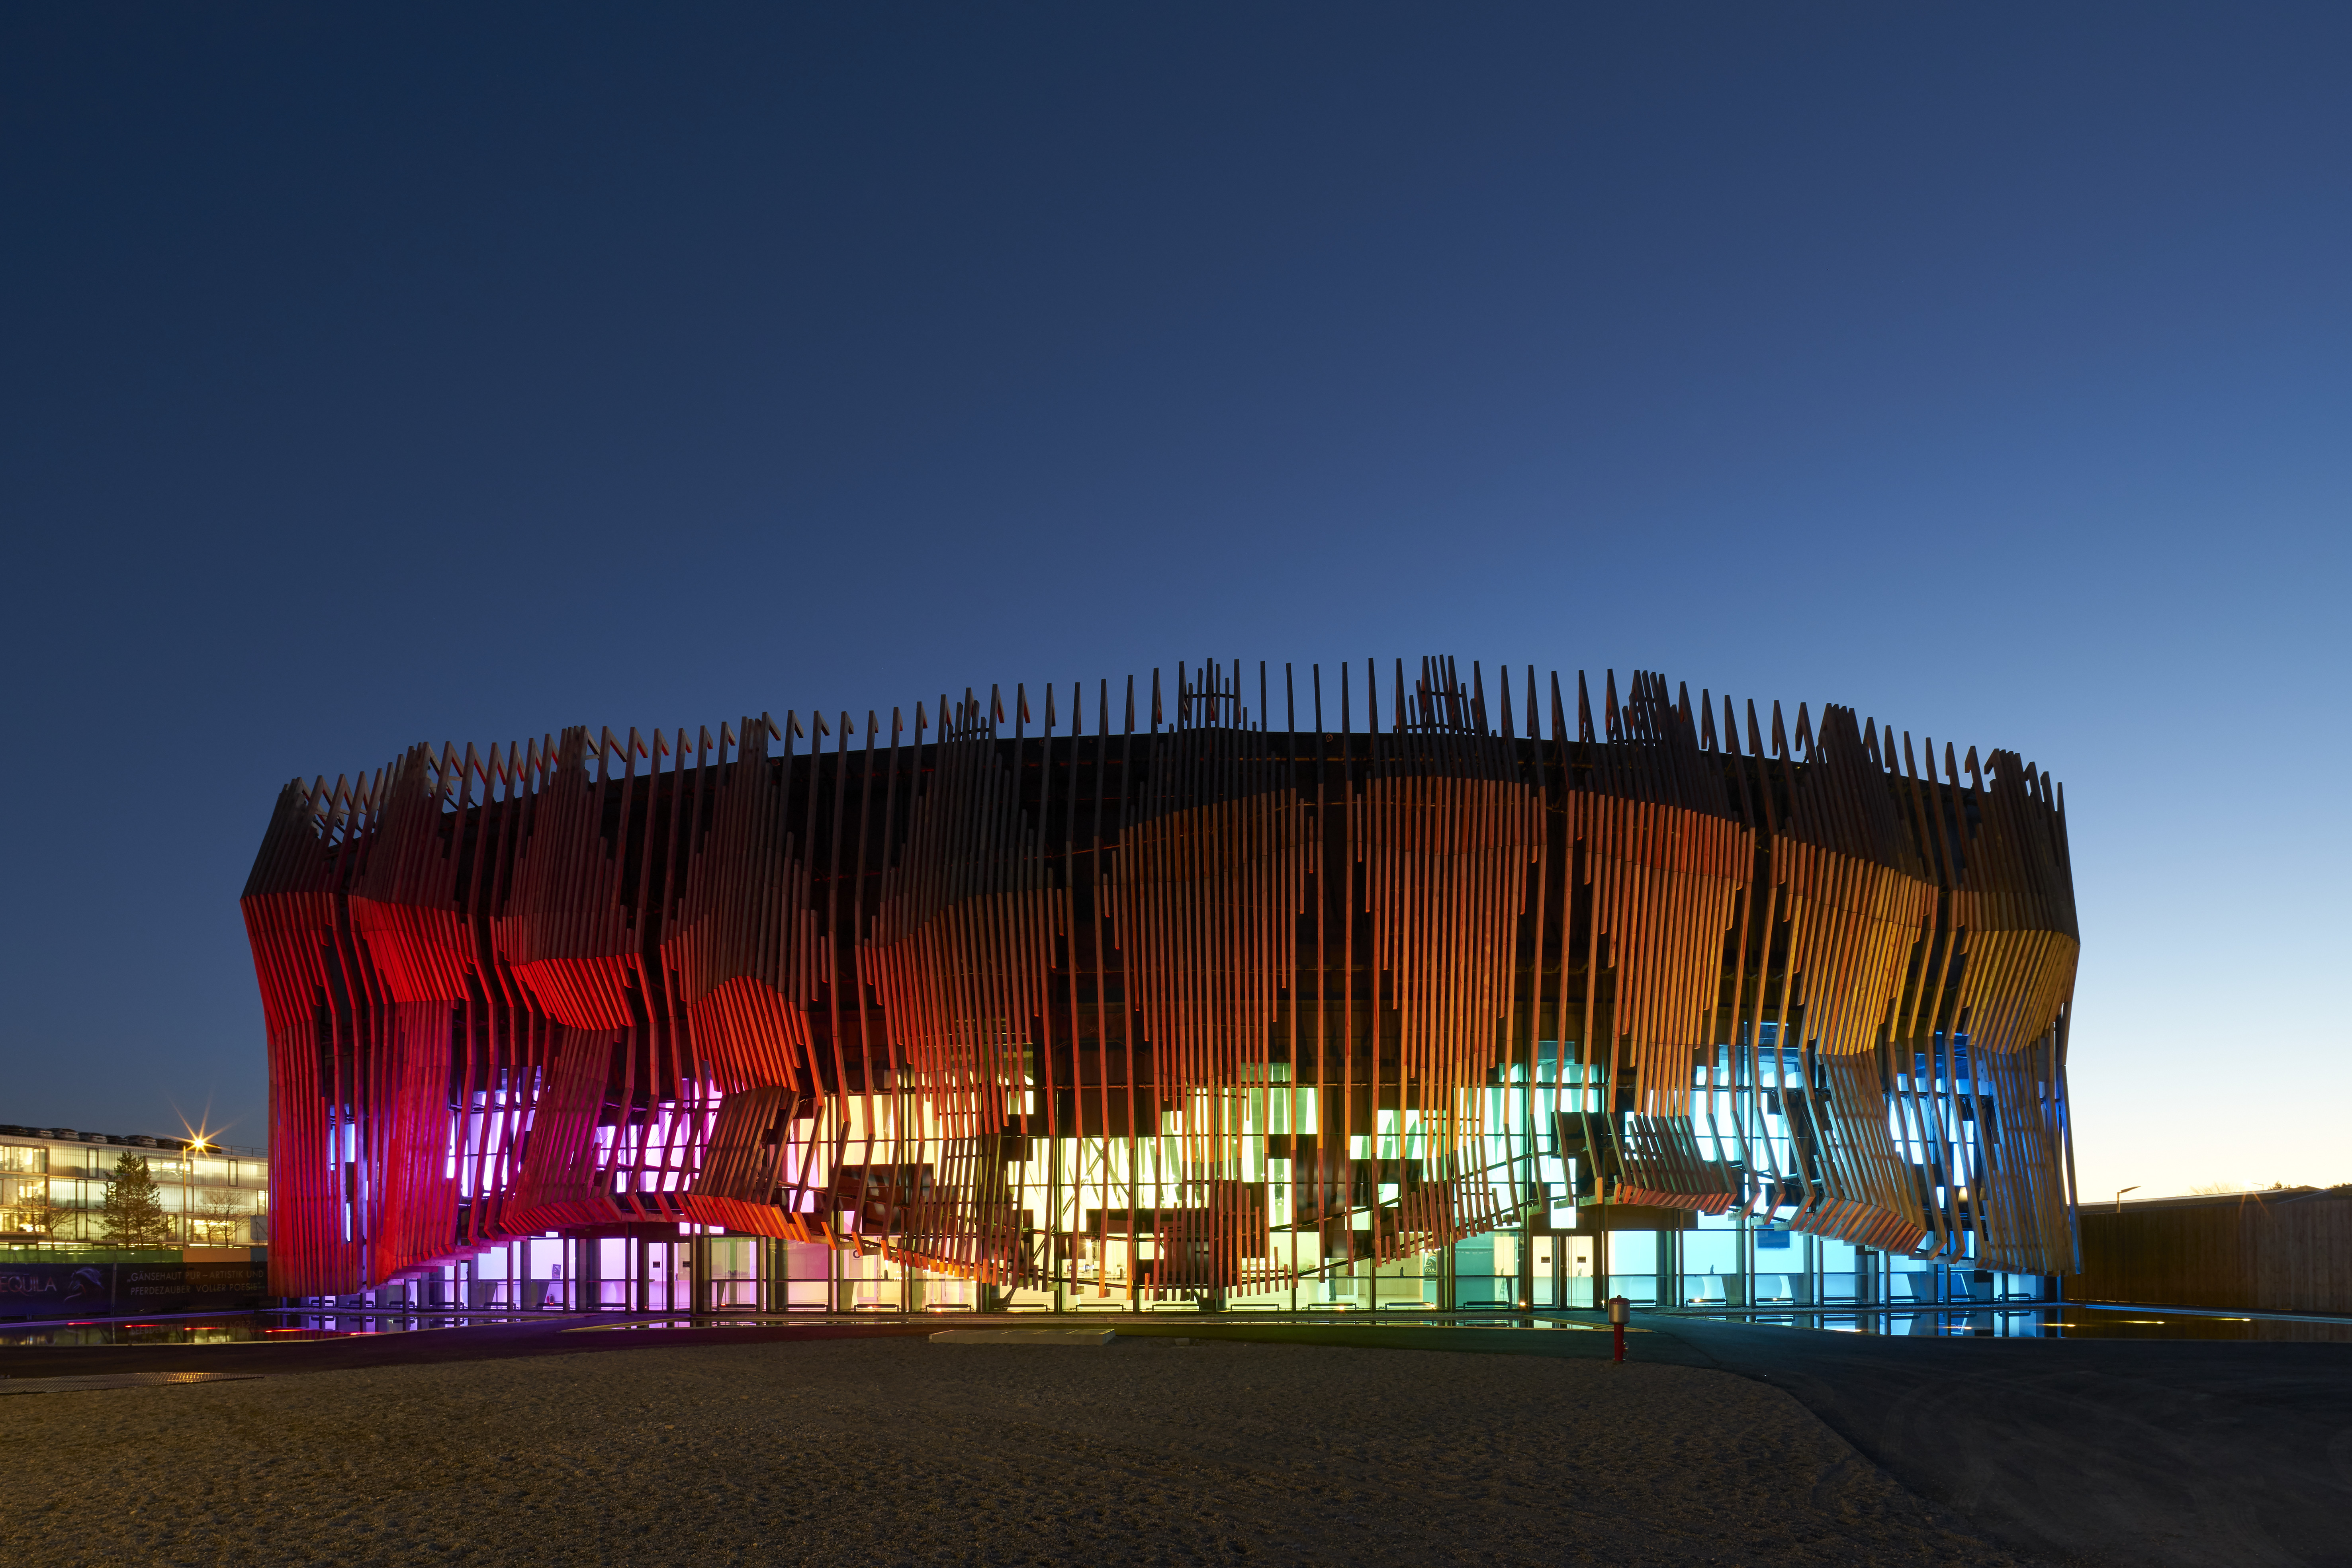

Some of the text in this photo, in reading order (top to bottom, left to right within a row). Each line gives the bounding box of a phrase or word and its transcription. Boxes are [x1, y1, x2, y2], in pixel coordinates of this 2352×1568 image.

[127, 1271, 182, 1283] „GÄNSEHAUT
[209, 1270, 244, 1279] ARTISTIK
[131, 1285, 191, 1295] PFERDEZAUBER
[196, 1284, 226, 1292] VOLLER
